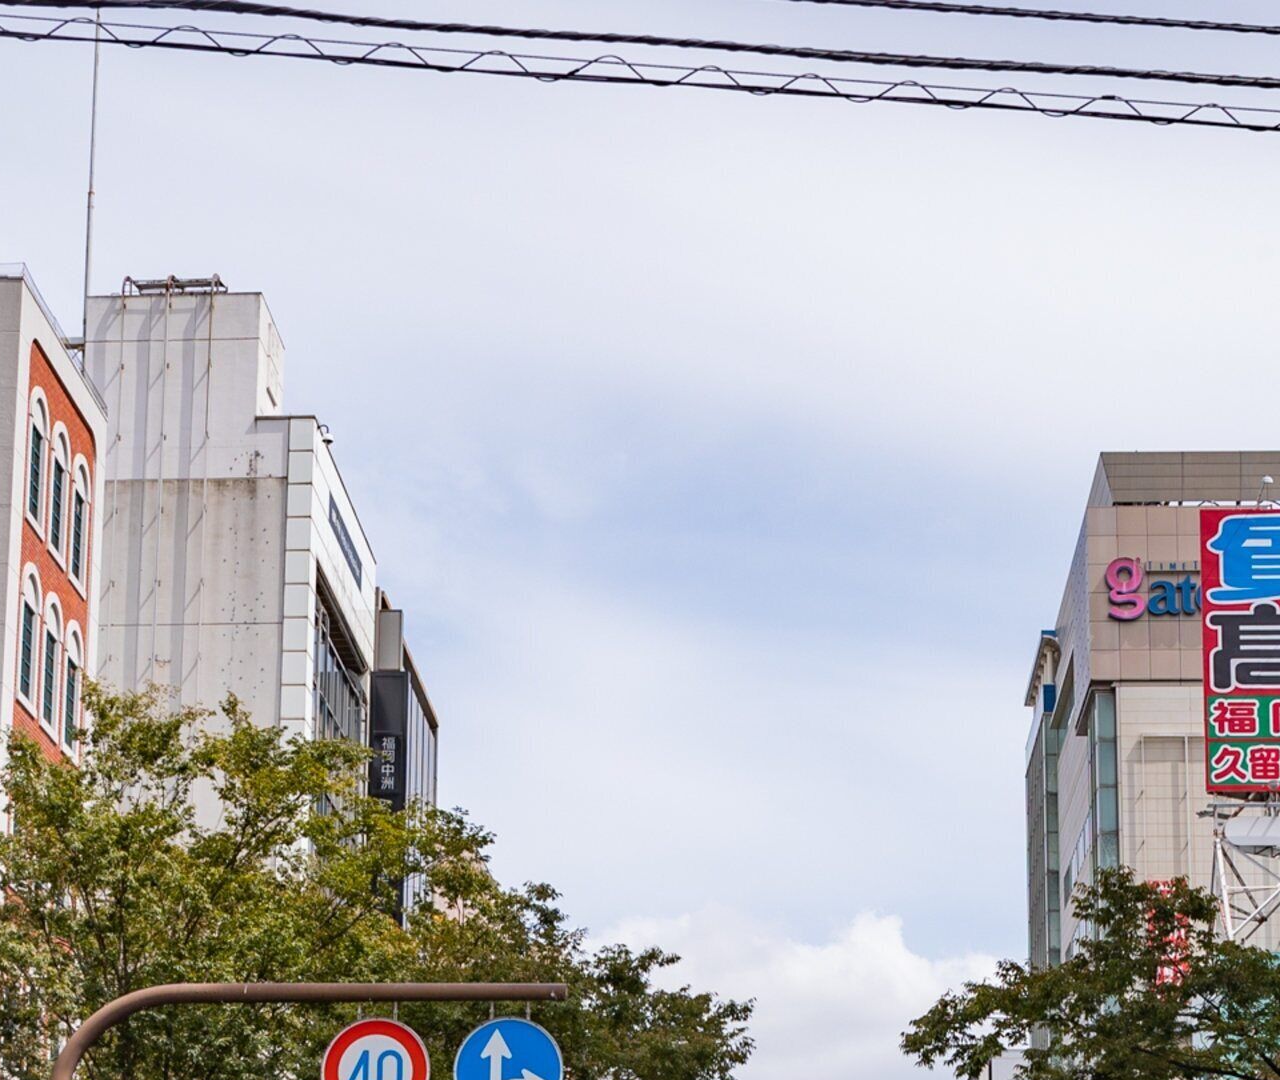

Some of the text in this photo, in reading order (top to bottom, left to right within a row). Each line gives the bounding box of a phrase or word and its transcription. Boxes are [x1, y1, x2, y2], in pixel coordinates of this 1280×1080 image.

[1105, 557, 1201, 621] gat
[381, 736, 396, 790] 福岡中洲
